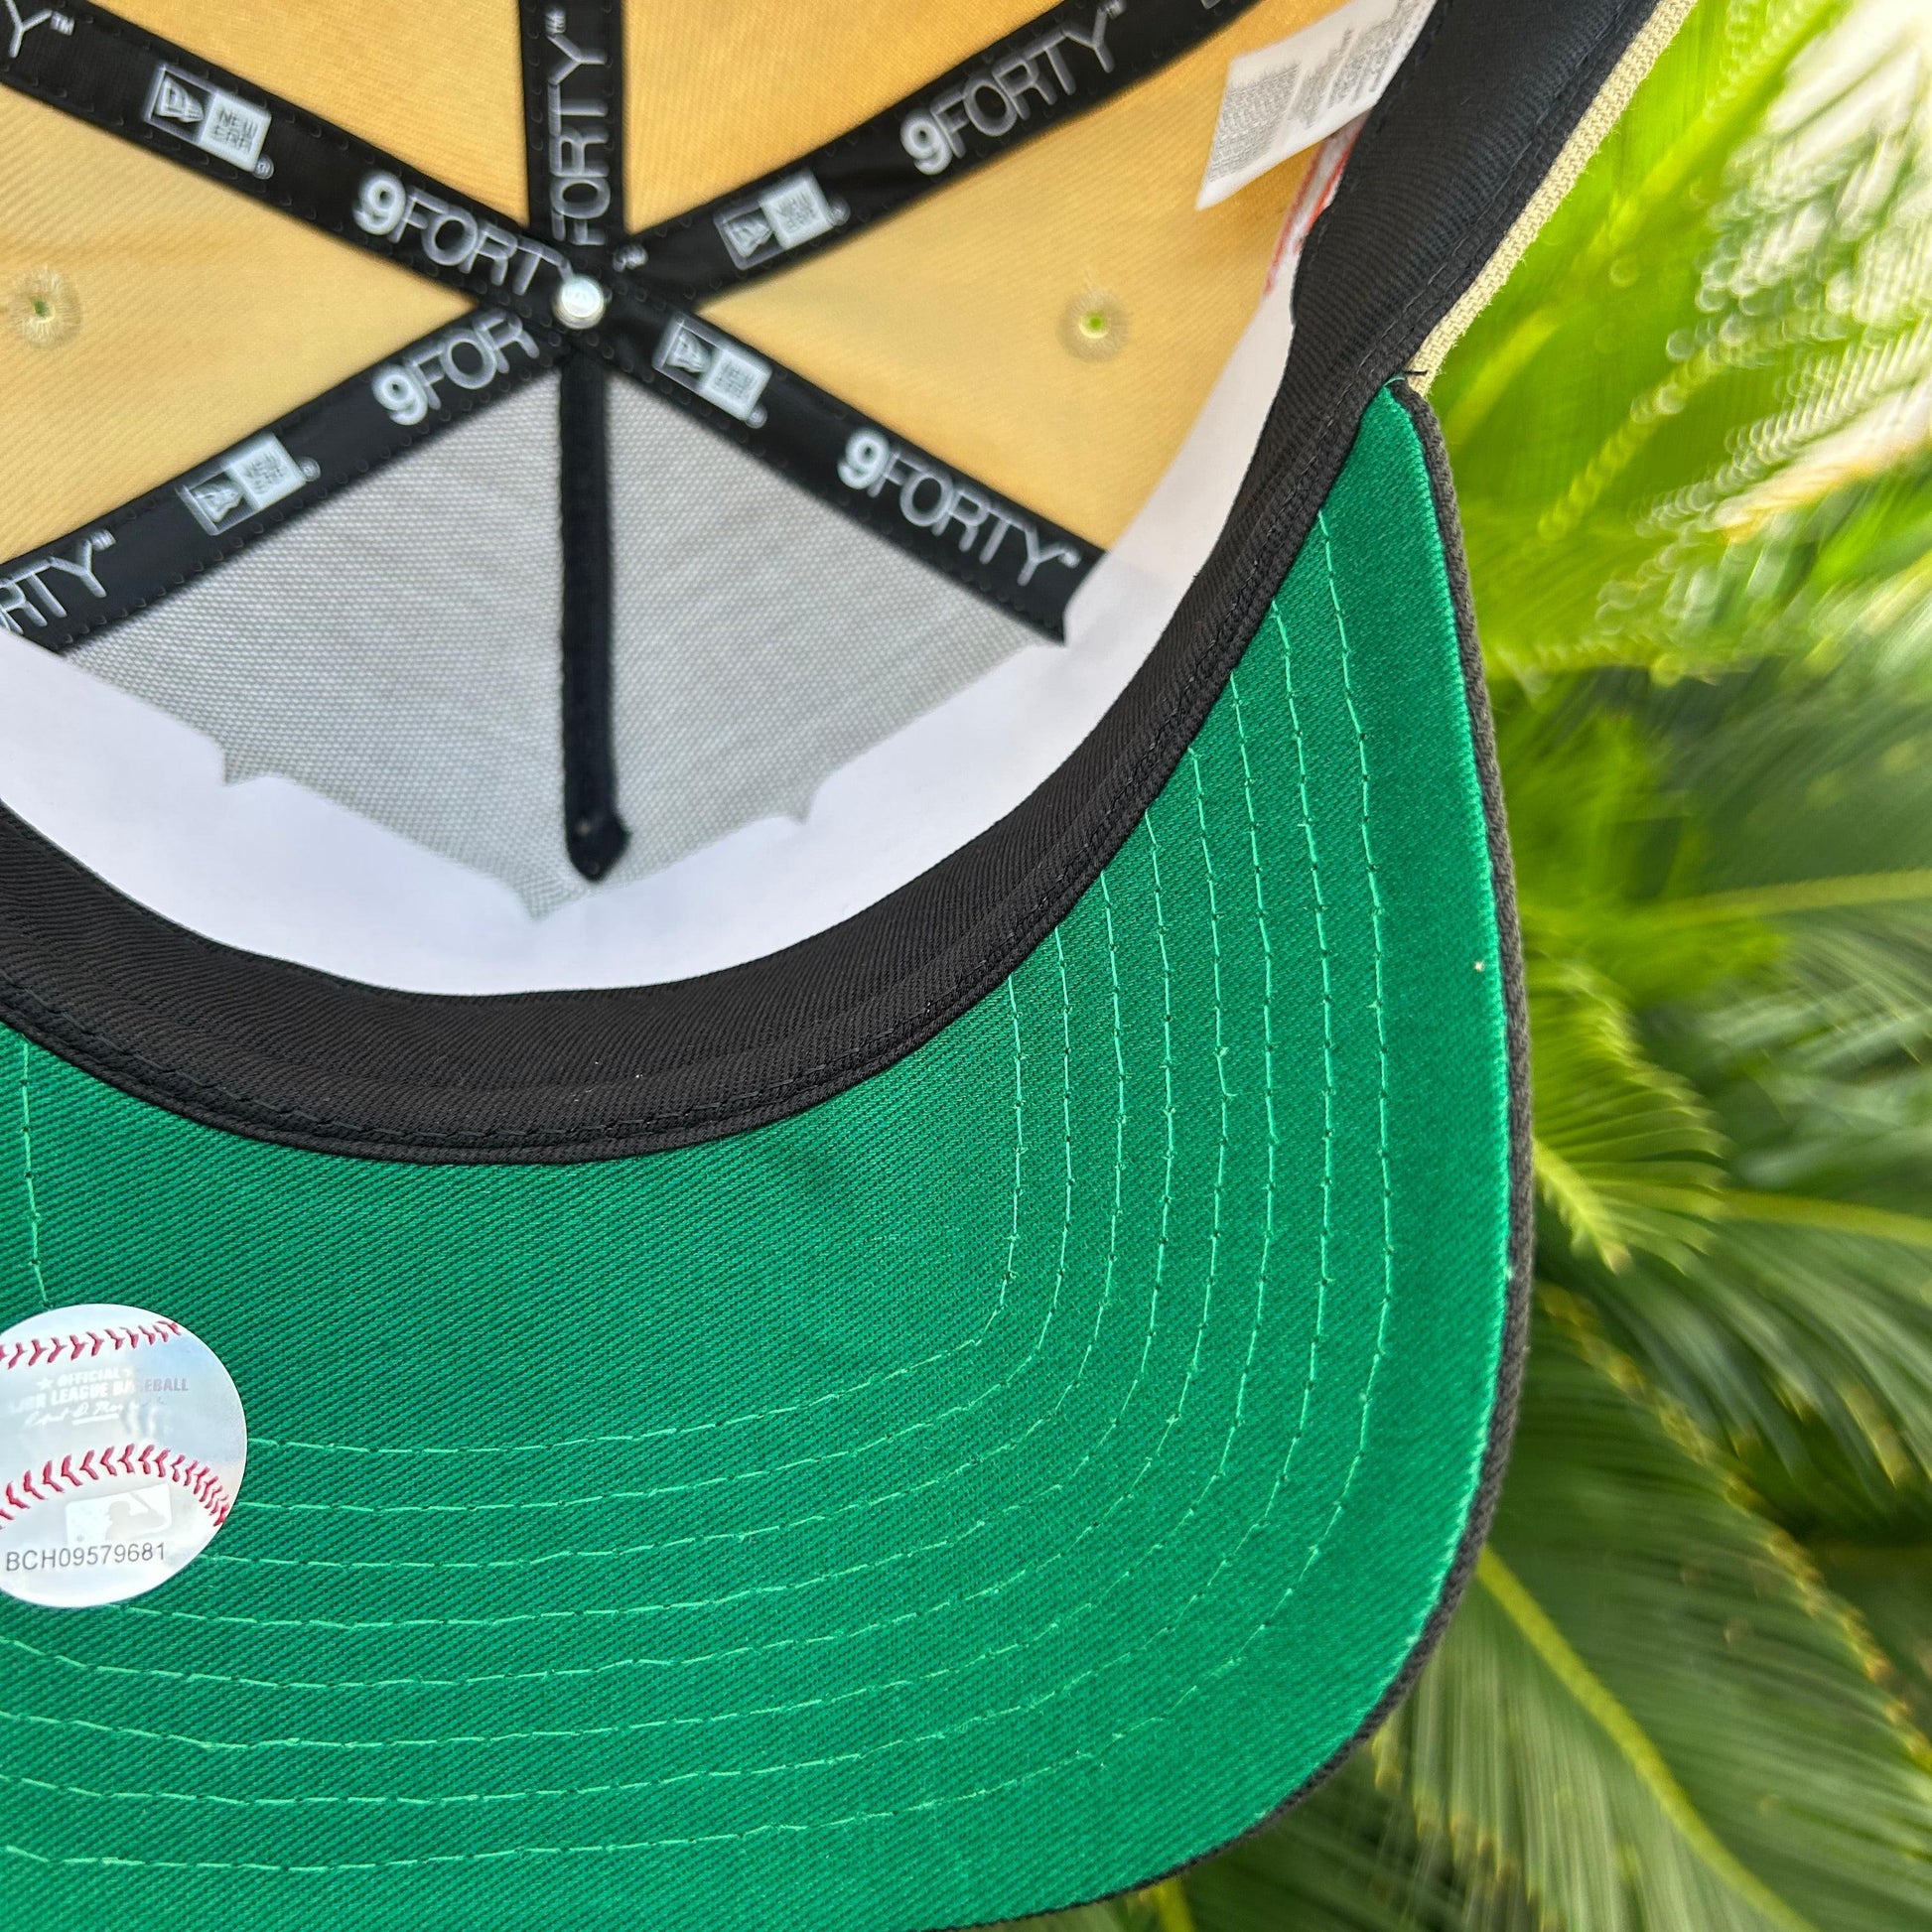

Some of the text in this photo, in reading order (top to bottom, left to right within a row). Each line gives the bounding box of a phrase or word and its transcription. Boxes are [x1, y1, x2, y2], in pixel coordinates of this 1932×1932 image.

[899, 8, 1115, 175] 9FORTY
[837, 427, 1056, 586] 9FORTY
[0, 539, 107, 634] RTY
[51, 1382, 108, 1406] LEAGUE
[112, 1377, 189, 1397] BAEBALL
[57, 1367, 120, 1388] OFFICIAL
[5, 1542, 166, 1572] BCH09579681
